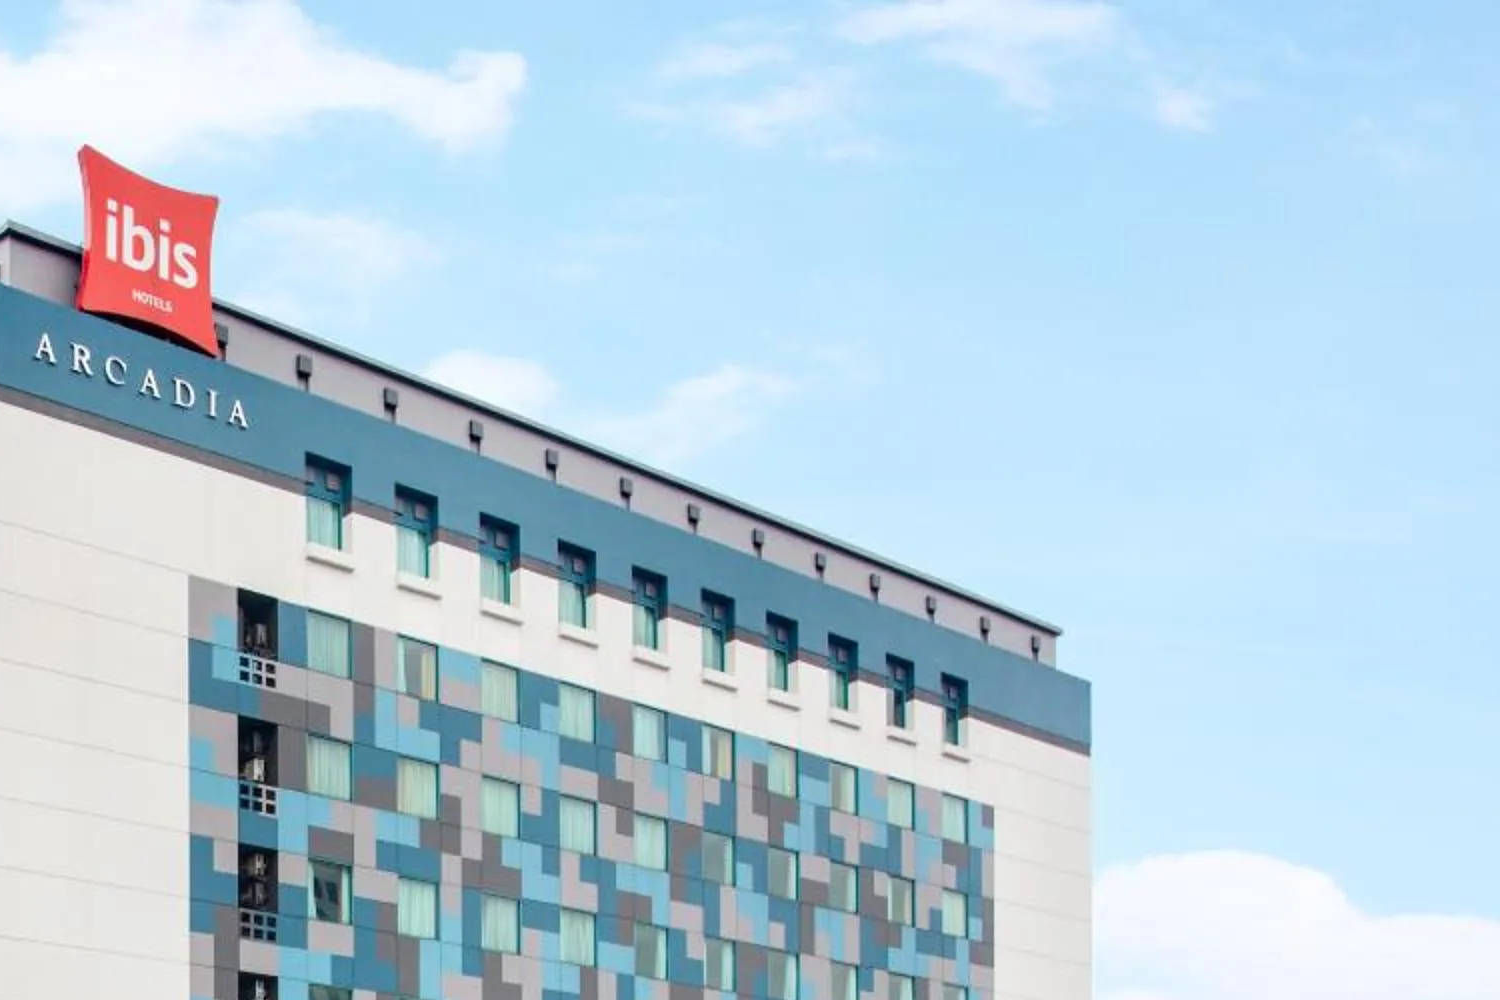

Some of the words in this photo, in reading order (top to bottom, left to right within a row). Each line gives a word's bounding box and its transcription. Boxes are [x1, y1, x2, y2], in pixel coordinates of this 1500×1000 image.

[105, 199, 197, 288] ibis
[132, 289, 173, 312] HOTELS
[35, 333, 249, 430] ARCADIA
